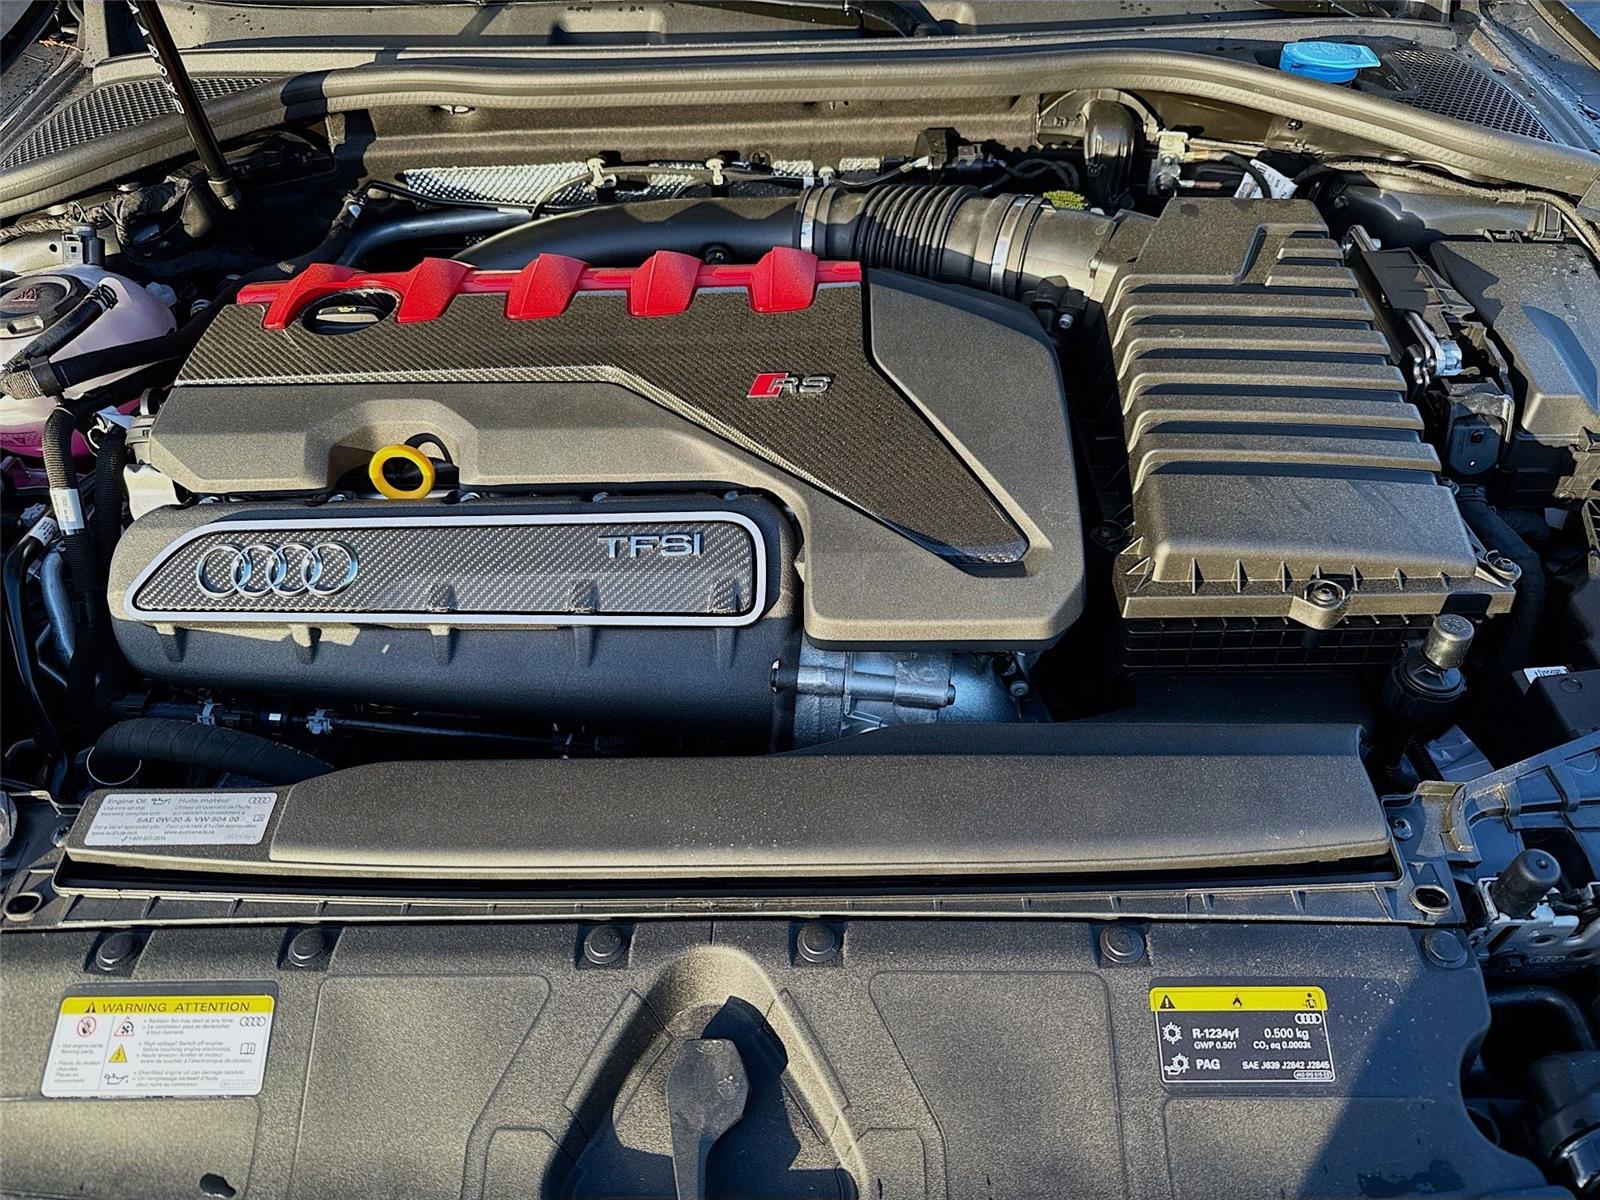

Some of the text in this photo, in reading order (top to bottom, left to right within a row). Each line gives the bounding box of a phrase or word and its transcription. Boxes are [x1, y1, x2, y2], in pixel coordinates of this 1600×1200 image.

[764, 375, 832, 395] RS
[597, 533, 703, 558] TFSI
[102, 1002, 250, 1013] WARNING ATTENTION
[1192, 1028, 1240, 1040] R-1234yf
[1264, 1028, 1309, 1040] 0.500 kg
[1194, 1041, 1237, 1049] GWP 0.501
[1282, 1041, 1312, 1049] 0.0003t
[1196, 1059, 1220, 1070] PAG
[1242, 1061, 1260, 1069] SAE
[1282, 1061, 1305, 1069] J2842
